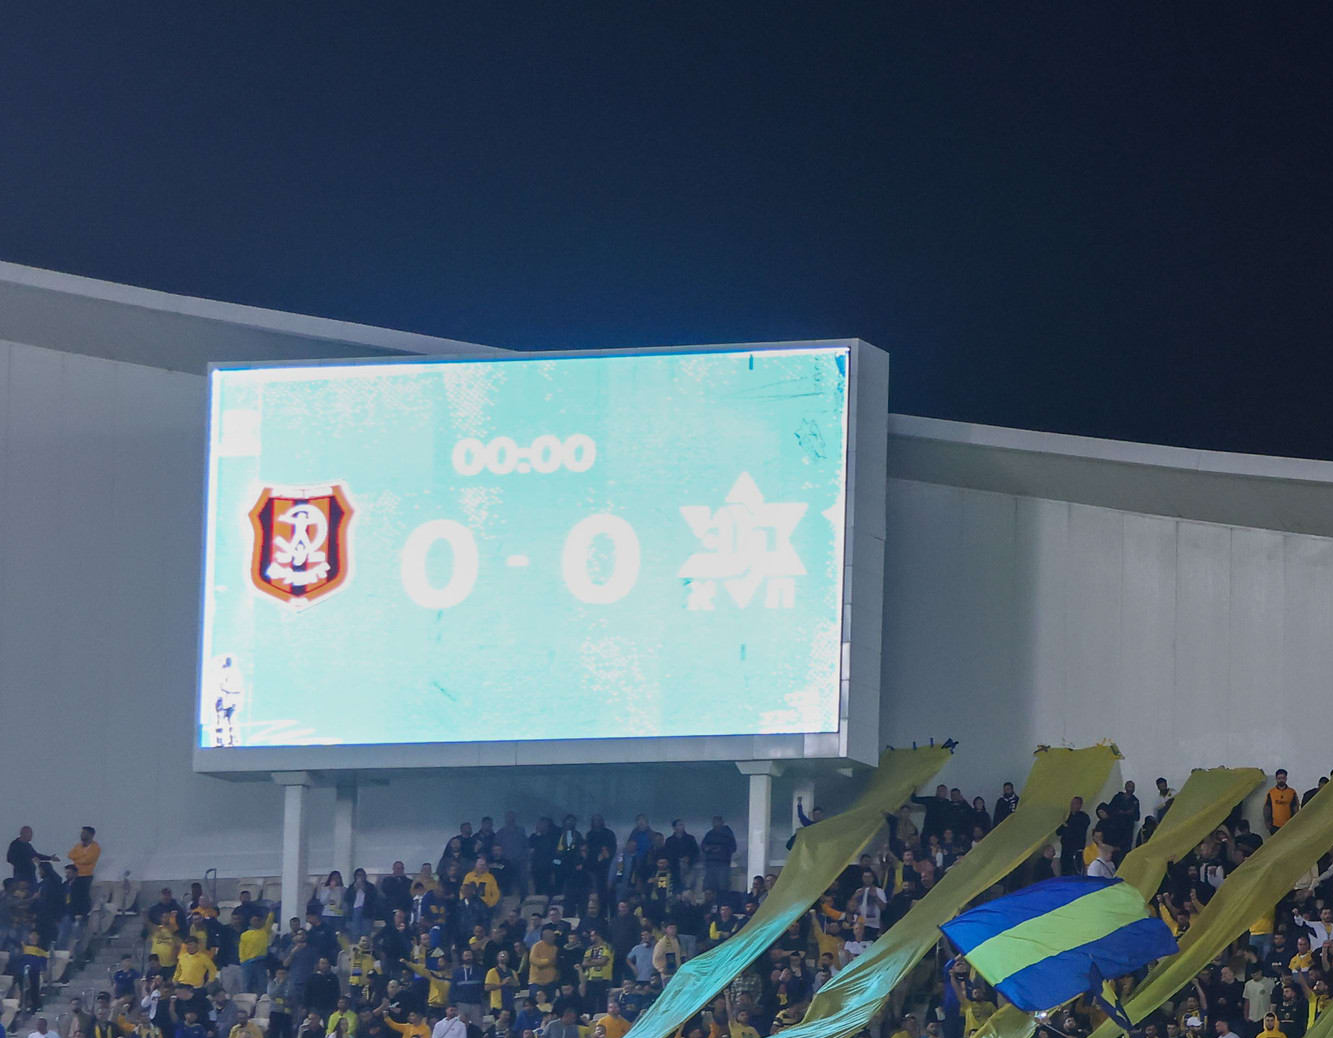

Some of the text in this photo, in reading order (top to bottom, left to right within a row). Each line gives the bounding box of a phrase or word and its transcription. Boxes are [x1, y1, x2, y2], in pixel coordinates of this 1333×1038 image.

[452, 434, 597, 476] 00:00
[400, 519, 479, 609] 0
[561, 512, 641, 604] 0
